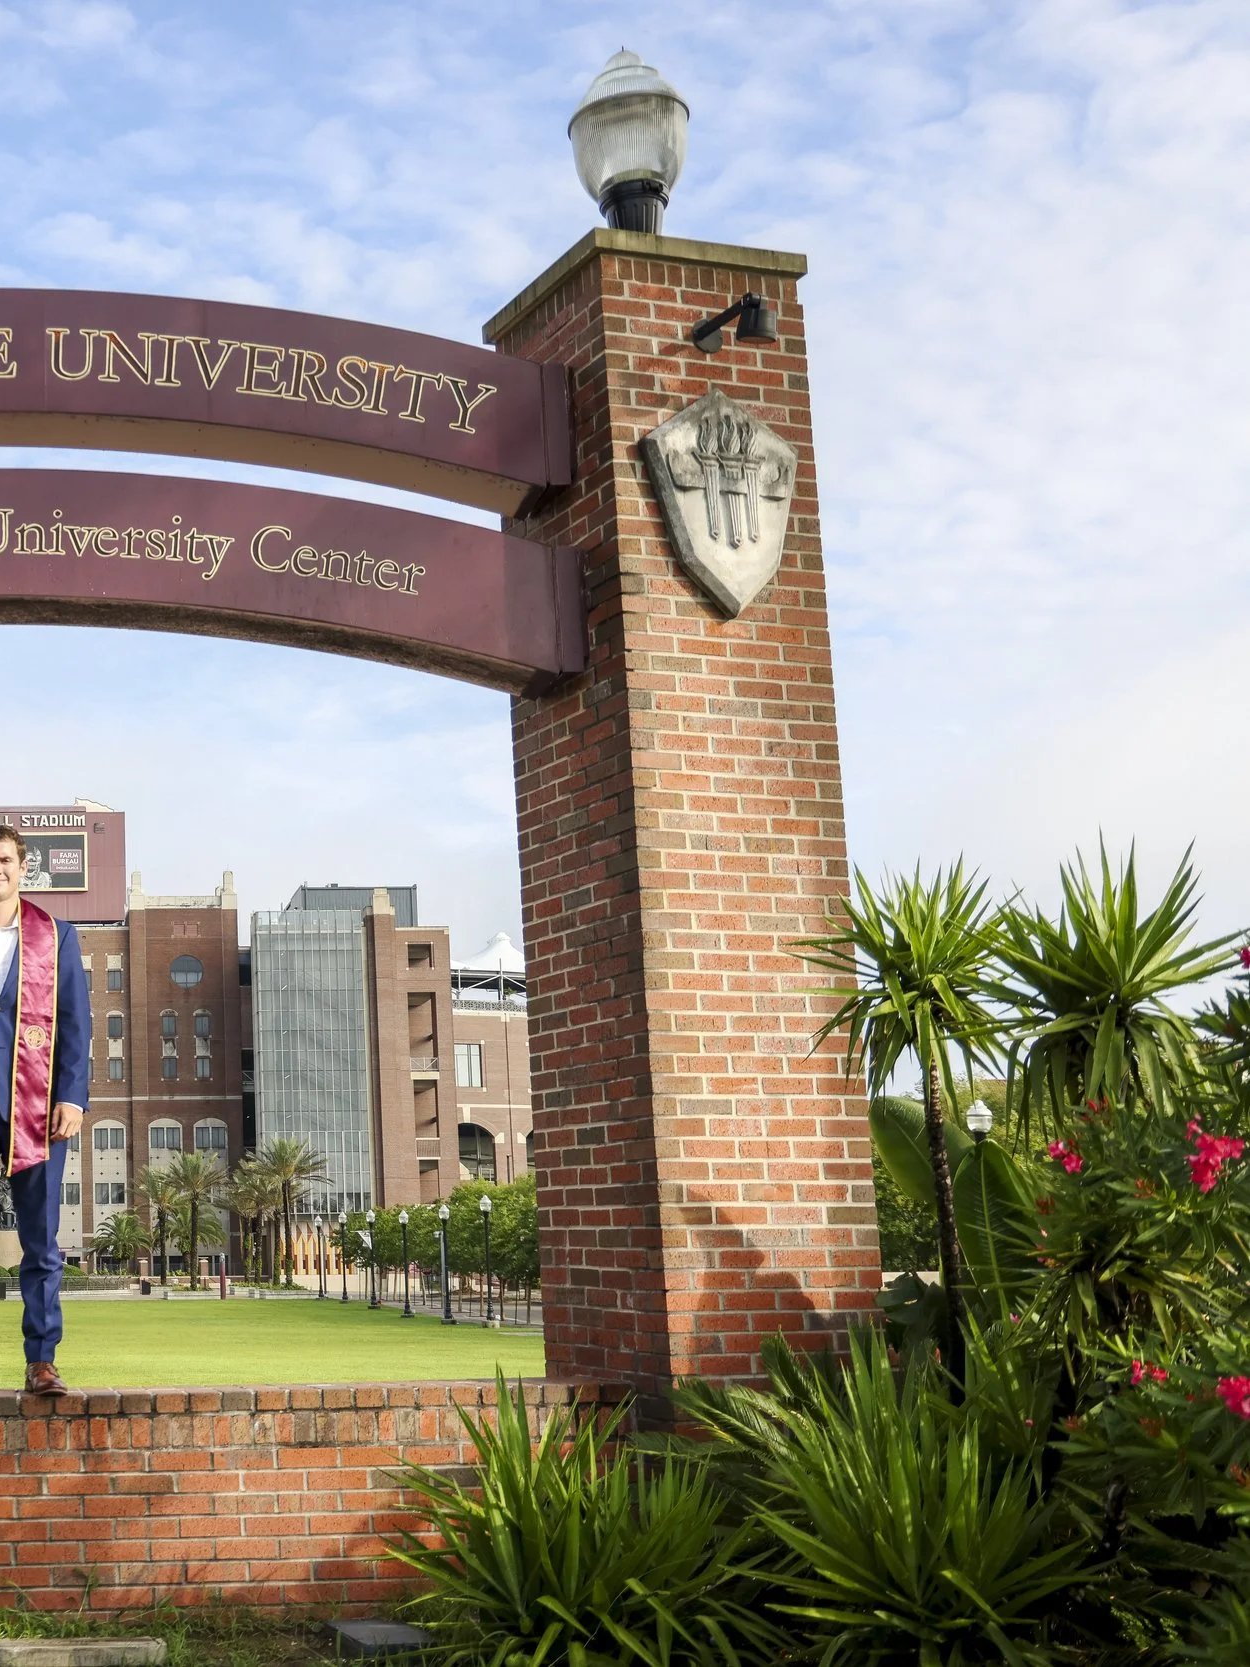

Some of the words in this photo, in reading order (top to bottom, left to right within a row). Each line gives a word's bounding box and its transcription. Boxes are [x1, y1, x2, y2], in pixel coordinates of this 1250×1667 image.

[46, 327, 498, 435] UNIVERSITY
[250, 525, 426, 596] Center
[21, 814, 86, 827] STADIUM
